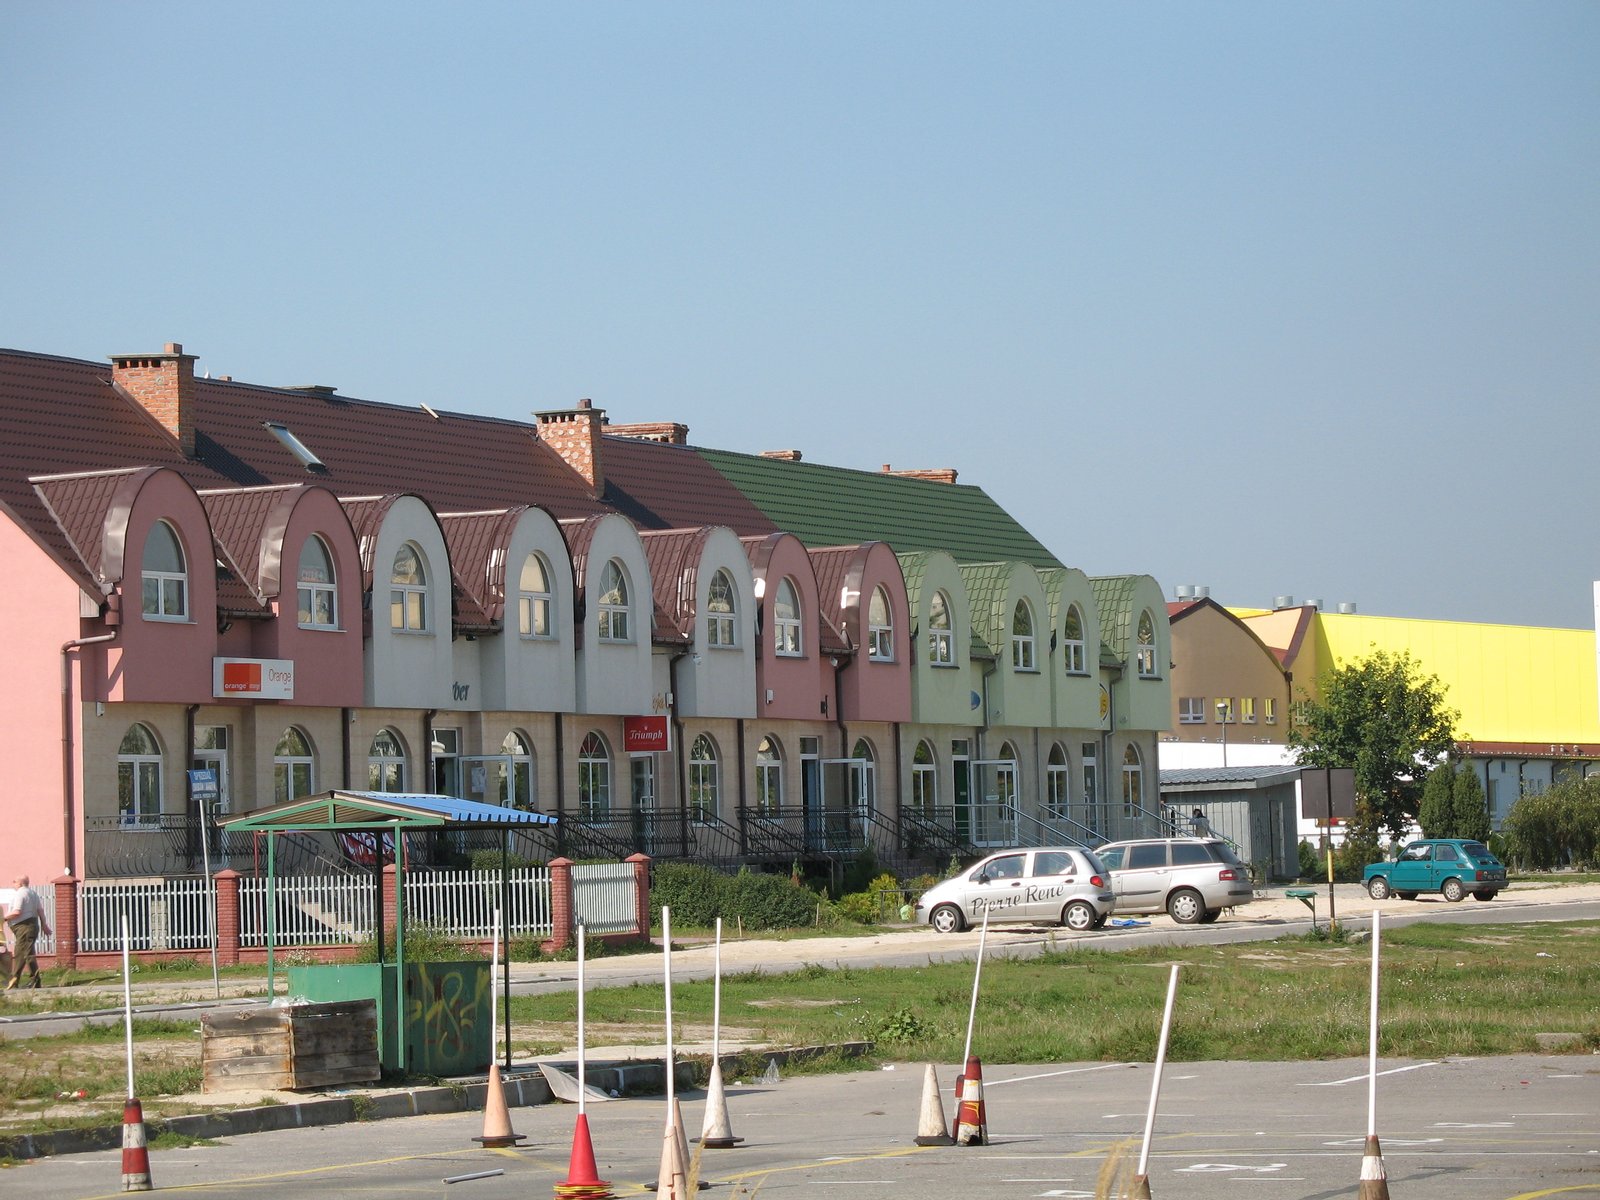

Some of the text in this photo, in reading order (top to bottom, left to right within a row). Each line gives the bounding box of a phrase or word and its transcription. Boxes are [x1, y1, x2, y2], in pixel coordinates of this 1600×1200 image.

[269, 669, 292, 685] Orange
[630, 730, 663, 741] Triumph
[971, 894, 1021, 915] Pierre
